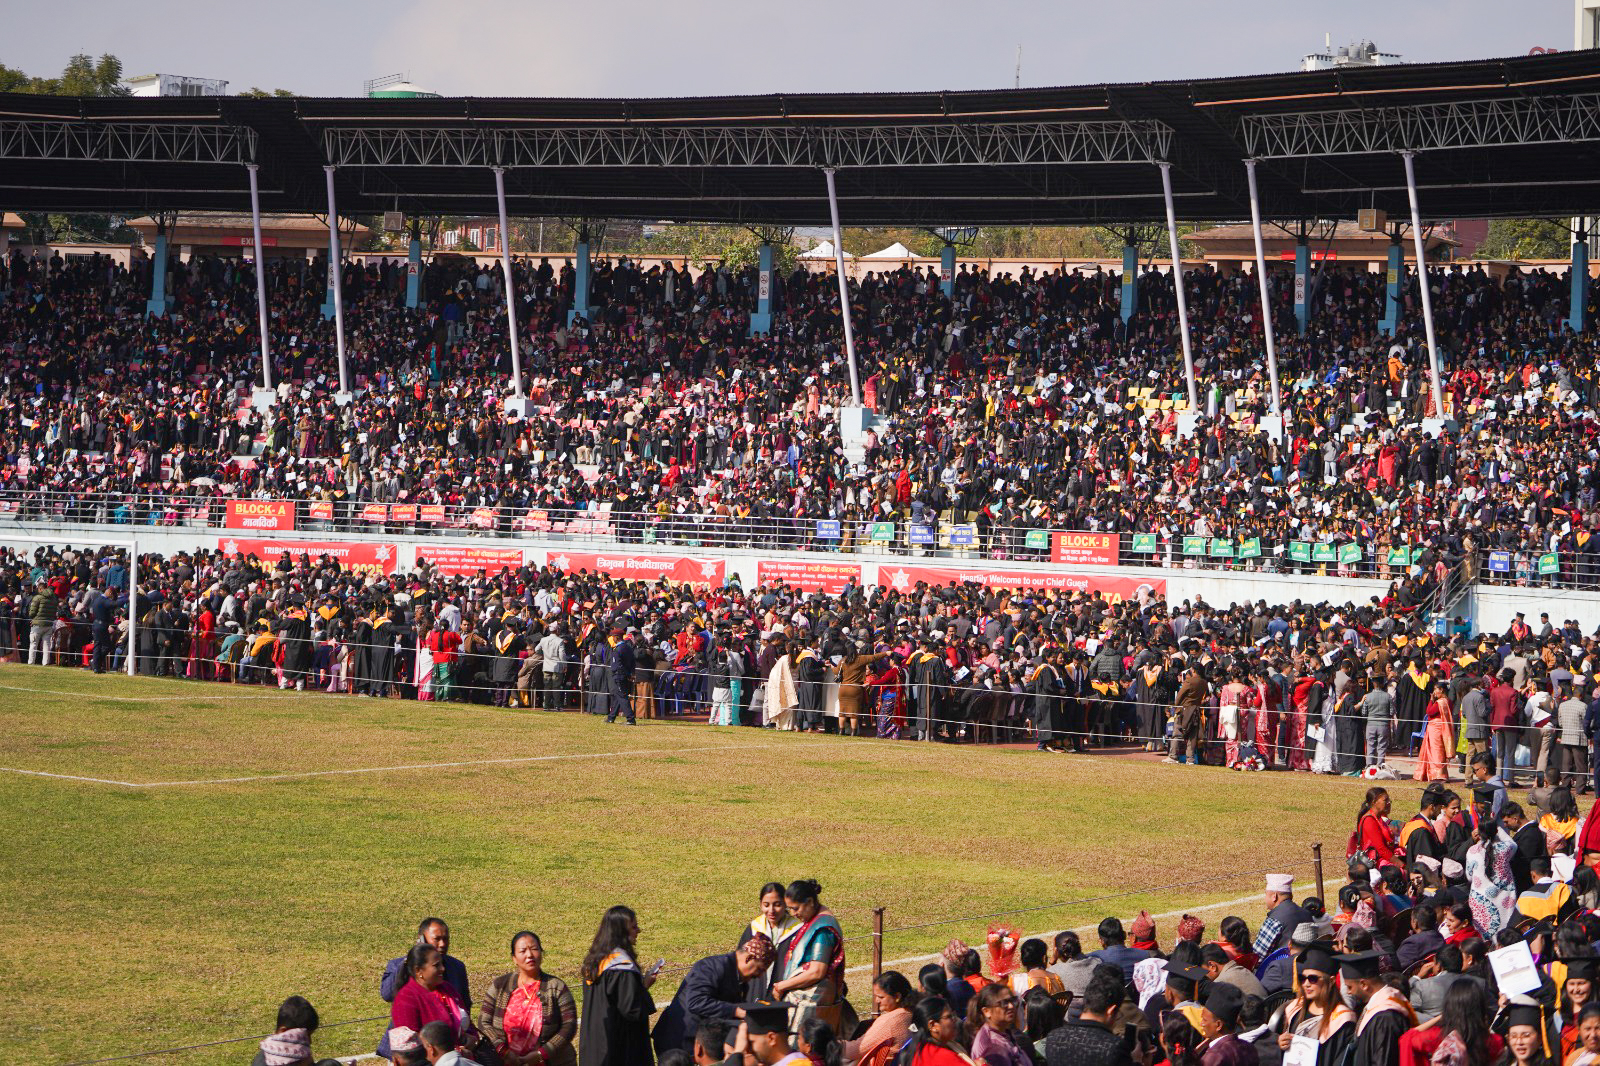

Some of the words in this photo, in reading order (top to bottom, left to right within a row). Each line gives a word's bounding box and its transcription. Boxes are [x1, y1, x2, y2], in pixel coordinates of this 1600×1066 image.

[241, 237, 255, 245] EXI
[235, 503, 276, 515] BLOCK-
[277, 505, 287, 515] A
[1060, 535, 1100, 547] BLOCK-
[1101, 537, 1110, 547] B
[307, 548, 350, 557] UNIVERSITY
[352, 562, 384, 576] 2025
[596, 557, 625, 570] त्रिभुवन
[626, 558, 675, 571] विश्वविद्यालय
[989, 574, 1022, 585] Welcome
[1023, 577, 1030, 585] to
[1046, 577, 1065, 587] Chief
[1066, 578, 1088, 588] Guest
